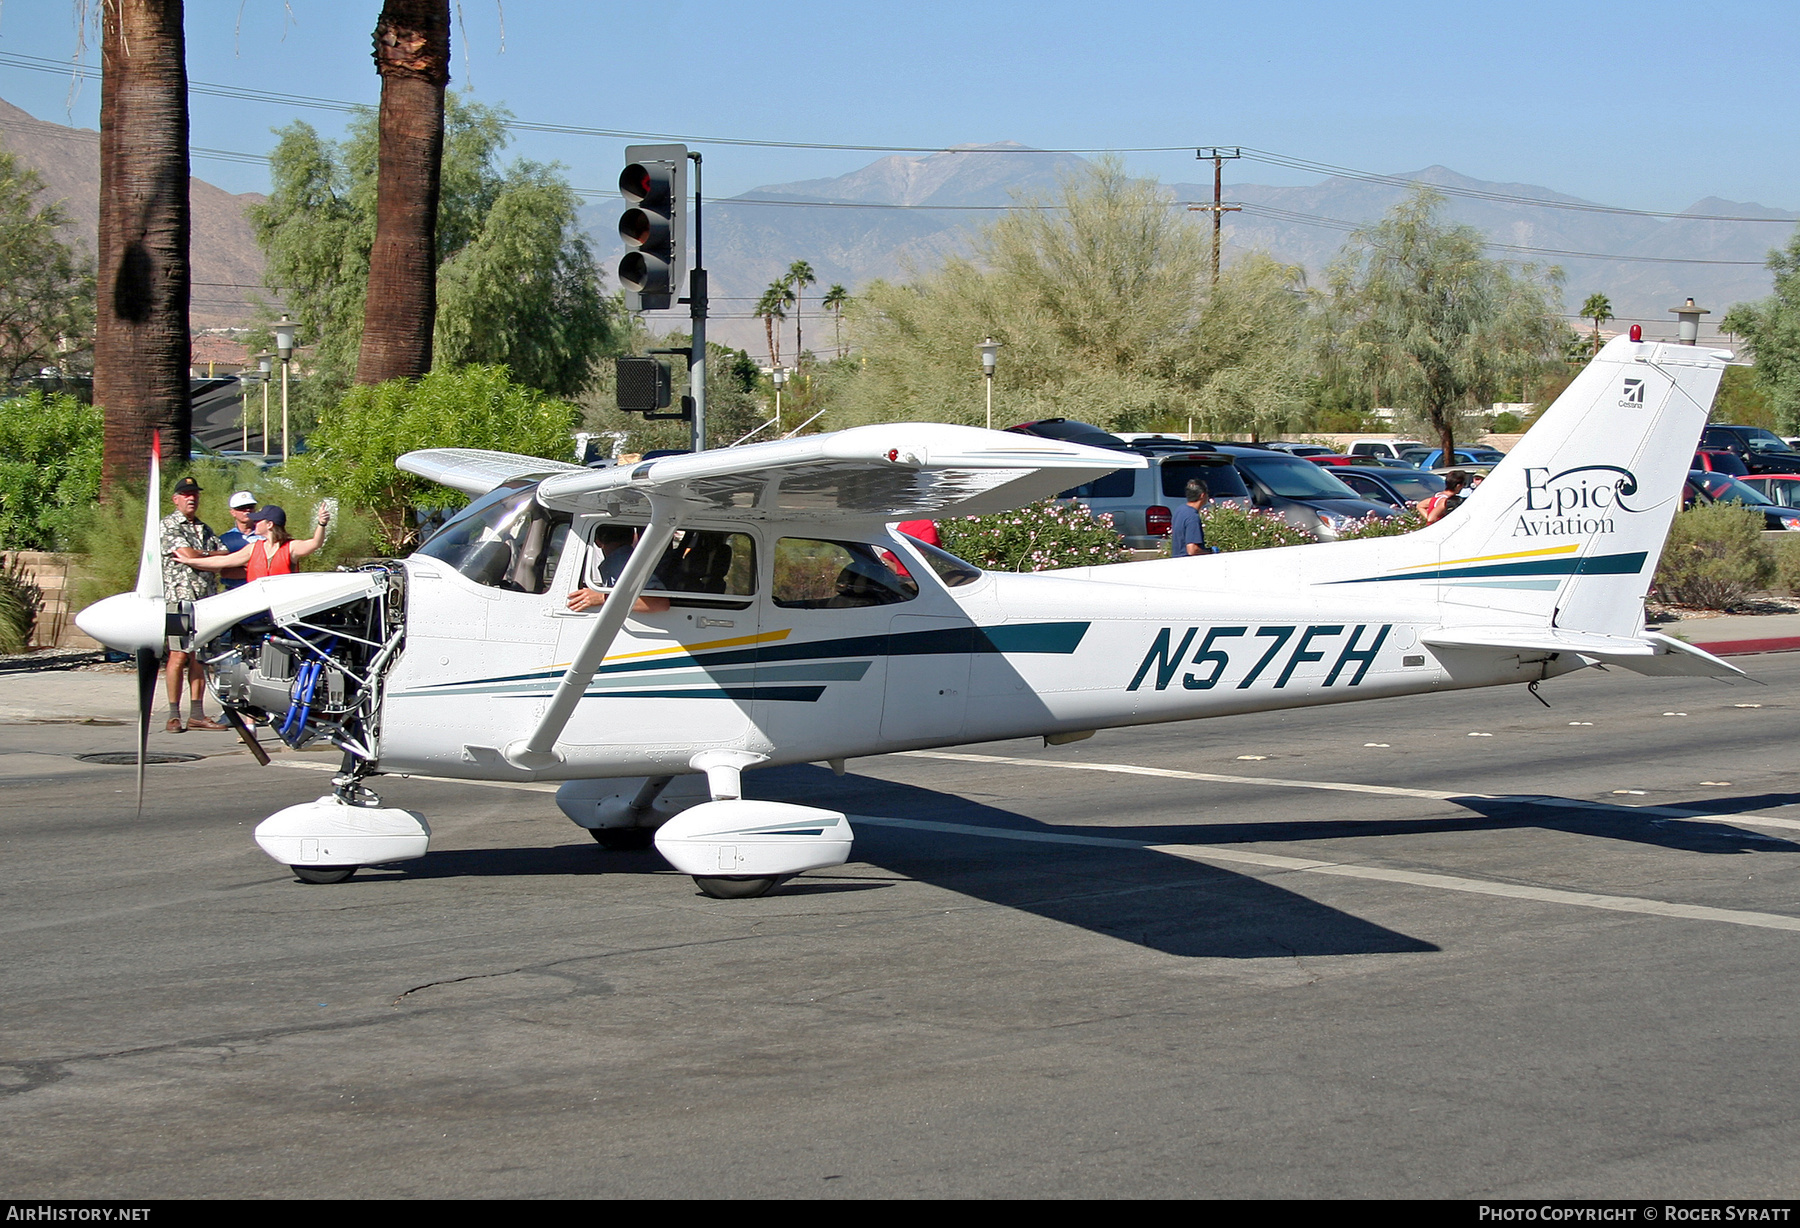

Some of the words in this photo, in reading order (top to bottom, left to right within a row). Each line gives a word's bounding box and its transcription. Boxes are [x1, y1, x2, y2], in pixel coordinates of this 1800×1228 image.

[1523, 466, 1612, 517] Epic
[1511, 513, 1615, 537] Aviation
[1125, 623, 1393, 692] N57FH
